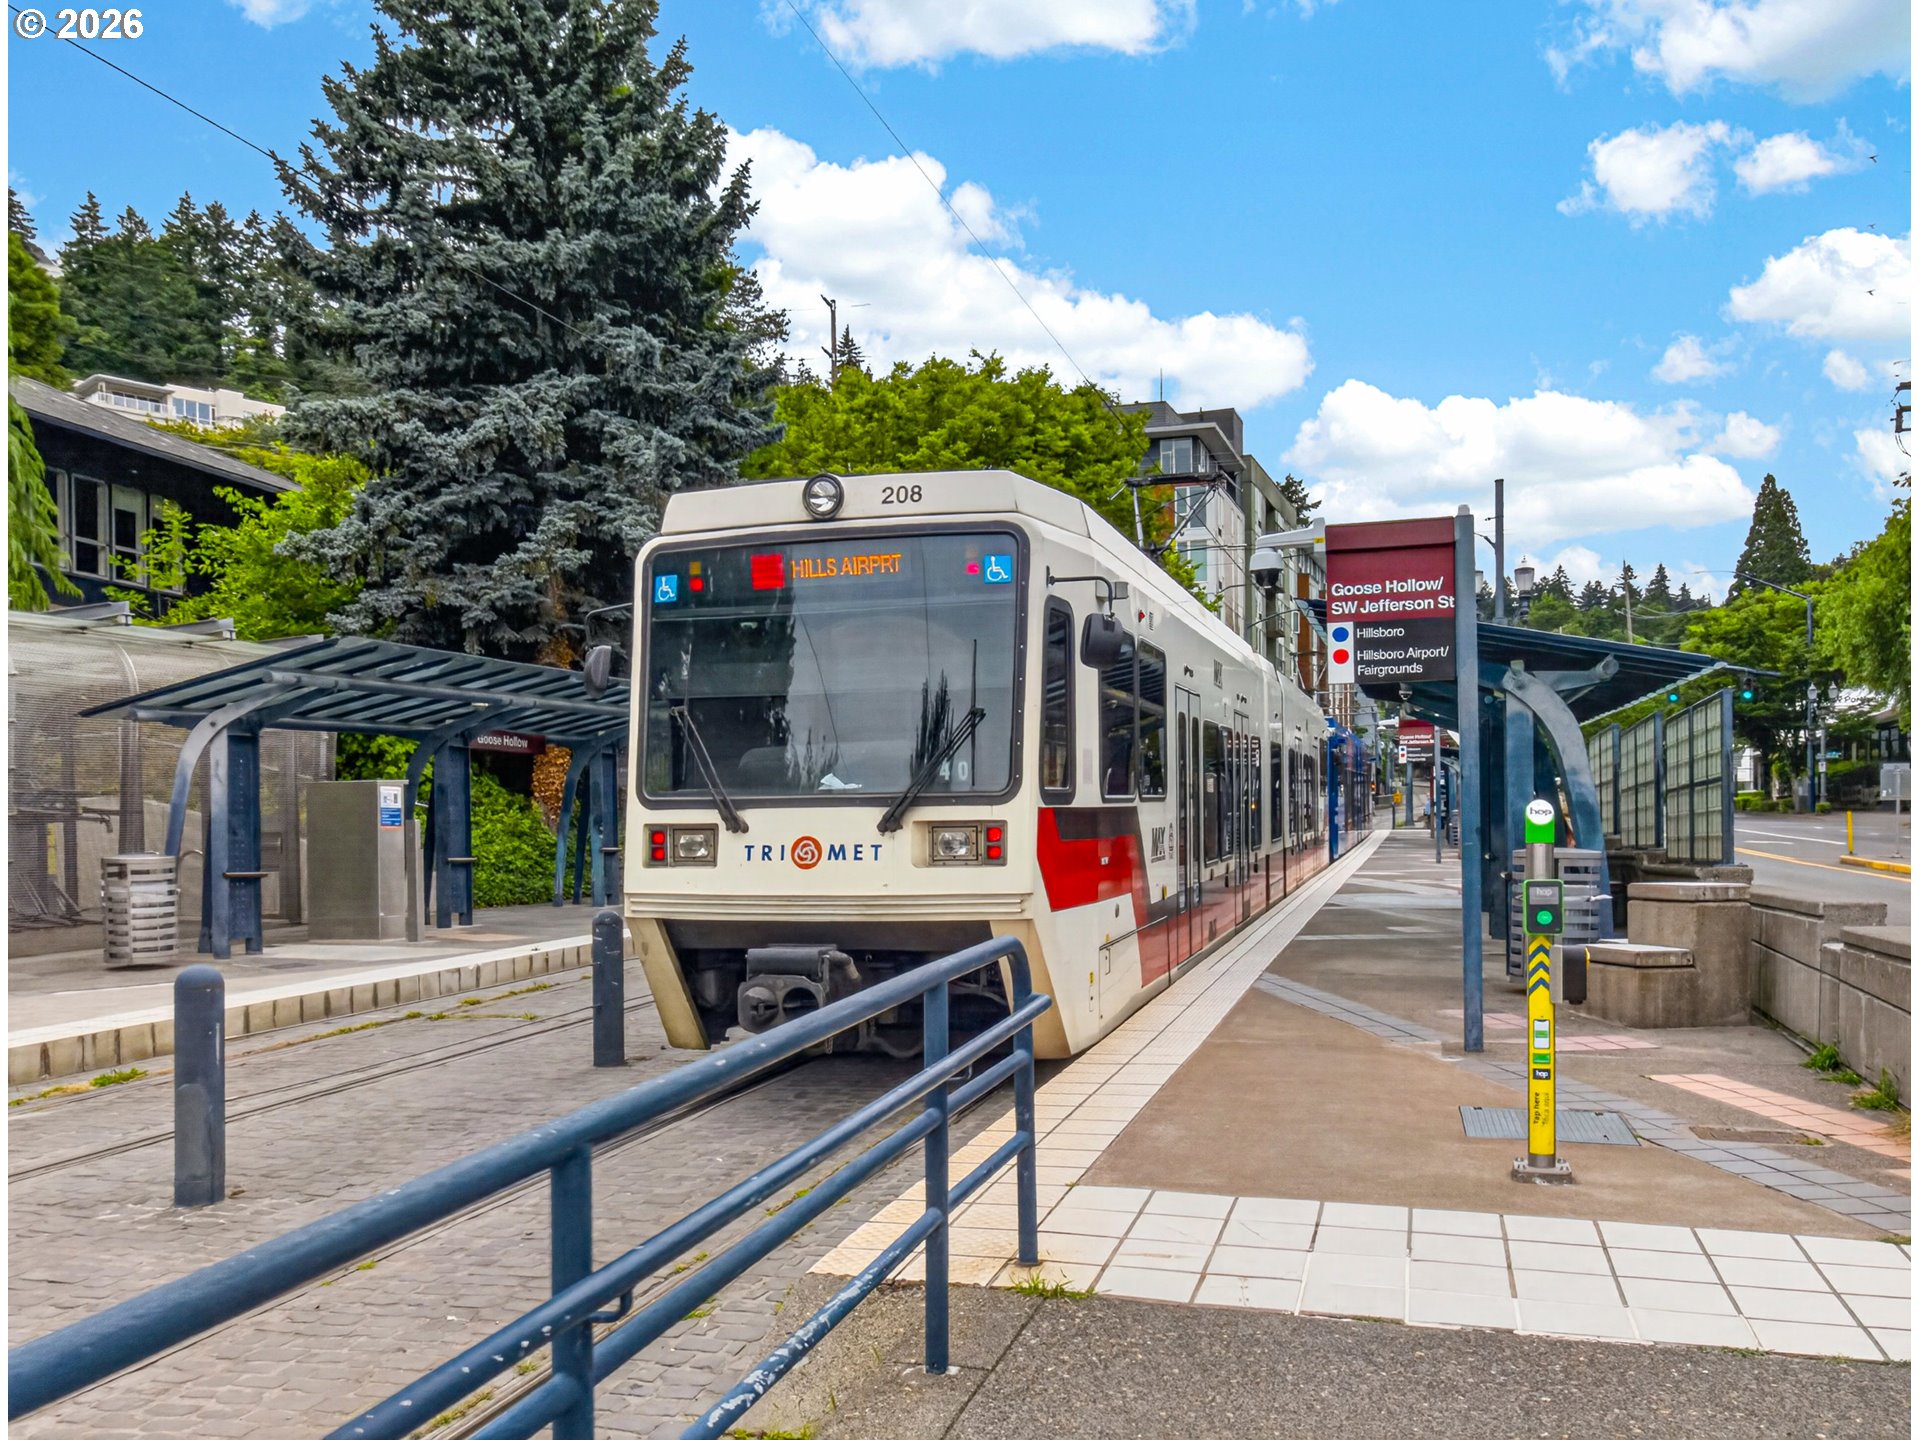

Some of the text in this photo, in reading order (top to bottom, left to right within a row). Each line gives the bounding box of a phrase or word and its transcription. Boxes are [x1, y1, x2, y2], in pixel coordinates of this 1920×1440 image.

[881, 485, 923, 504] 208
[791, 552, 902, 579] HILLS AIRPRT
[1331, 576, 1444, 596] Goose Hollow/
[1331, 595, 1455, 615] SW Jefferson St
[1357, 627, 1404, 638] Hillsboro
[1357, 645, 1449, 661] Hillsboro Airport/
[1357, 663, 1423, 677] Fairgrounds
[477, 735, 528, 748] Goose Hollow
[1530, 806, 1552, 816] hop
[1536, 886, 1552, 897] hop
[1536, 1069, 1549, 1078] hop
[1533, 1110, 1541, 1124] Tap
